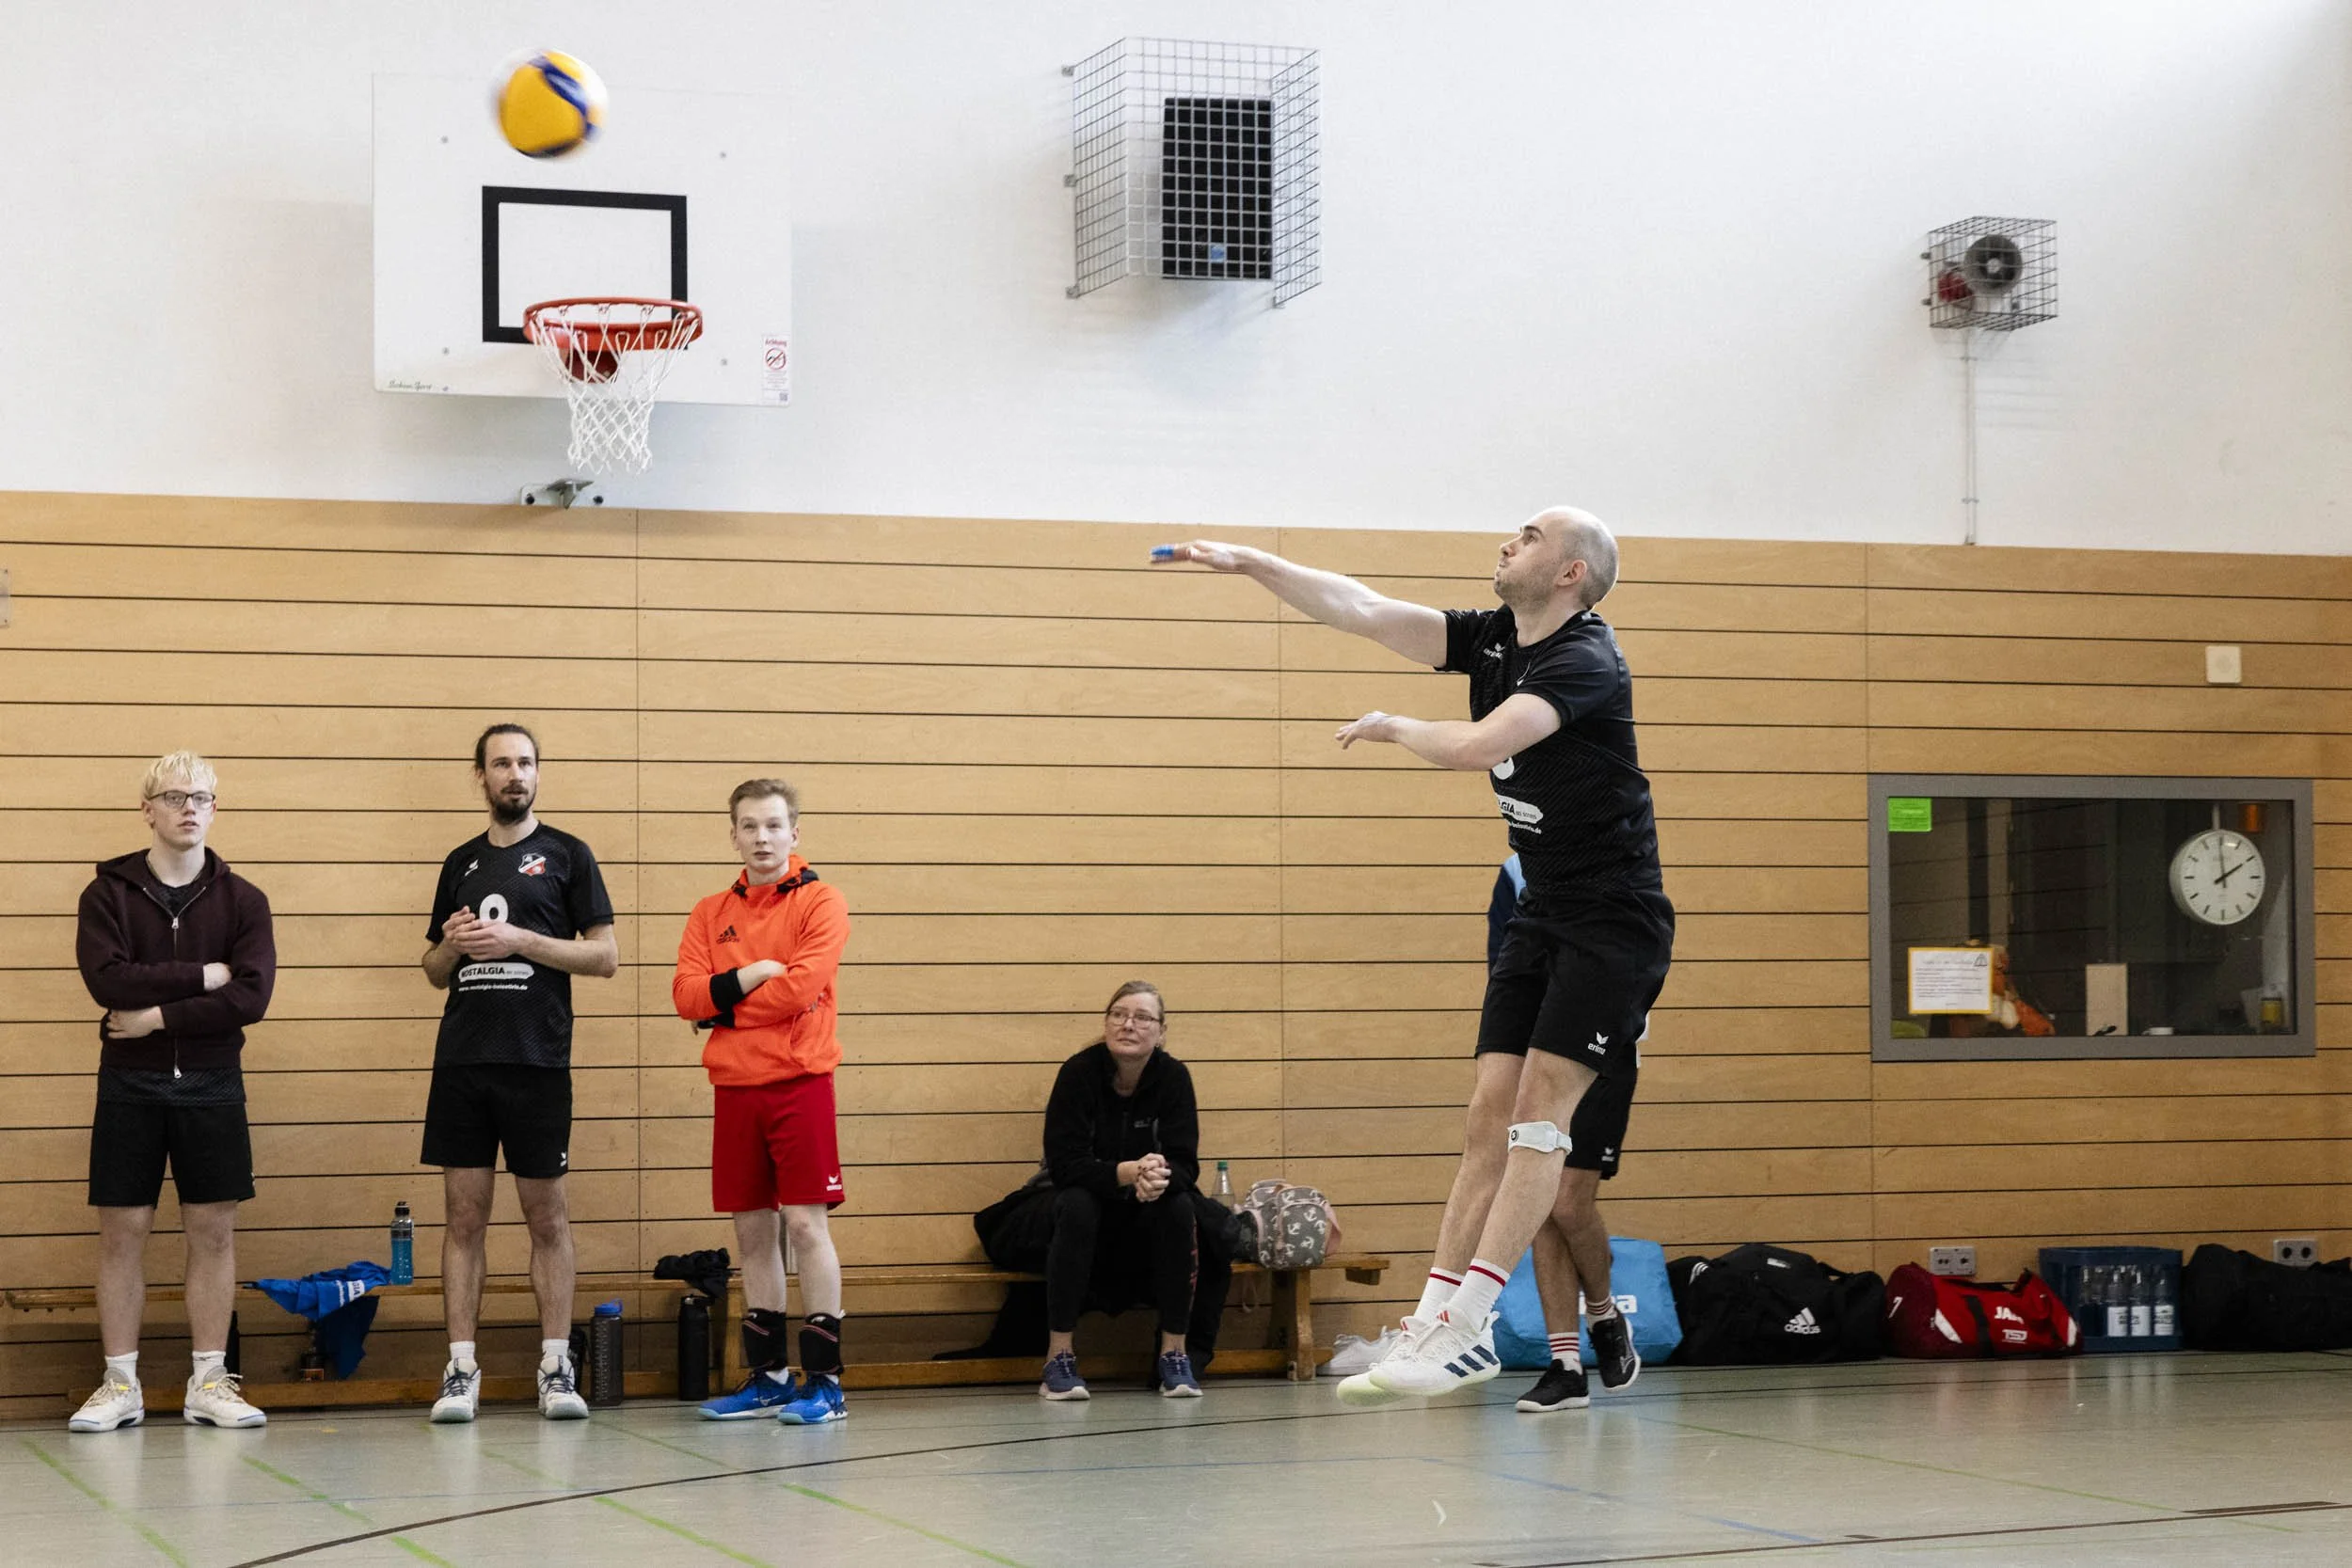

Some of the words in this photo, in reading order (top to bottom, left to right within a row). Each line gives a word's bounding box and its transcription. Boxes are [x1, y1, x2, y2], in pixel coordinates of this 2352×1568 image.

[461, 967, 505, 978] NOSTALGIA
[1587, 1042, 1606, 1055] erima
[1784, 1323, 1821, 1335] adidas
